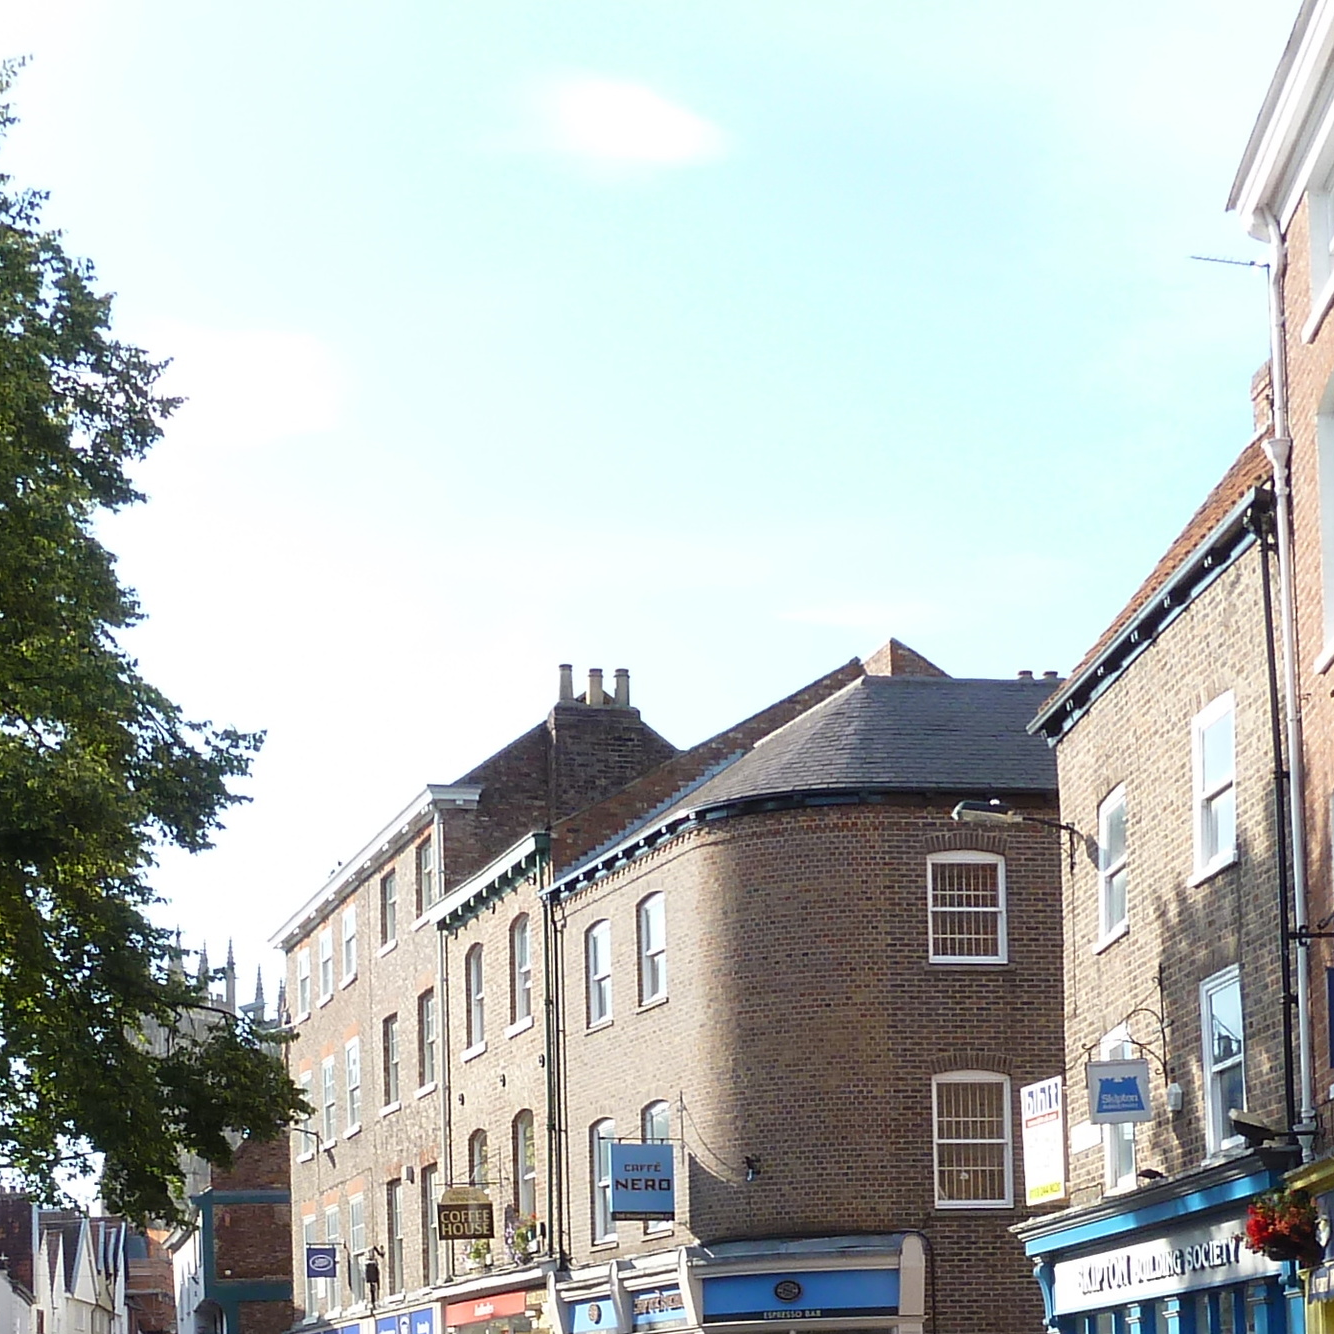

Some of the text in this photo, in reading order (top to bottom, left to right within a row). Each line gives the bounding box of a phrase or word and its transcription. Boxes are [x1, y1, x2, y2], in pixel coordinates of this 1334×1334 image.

[615, 1178, 671, 1191] NERO
[440, 1209, 490, 1223] COFFEE
[442, 1222, 491, 1236] HOUSE
[1185, 1236, 1241, 1272] SOCIETY
[763, 1309, 822, 1320] ESPRESSO BAR
